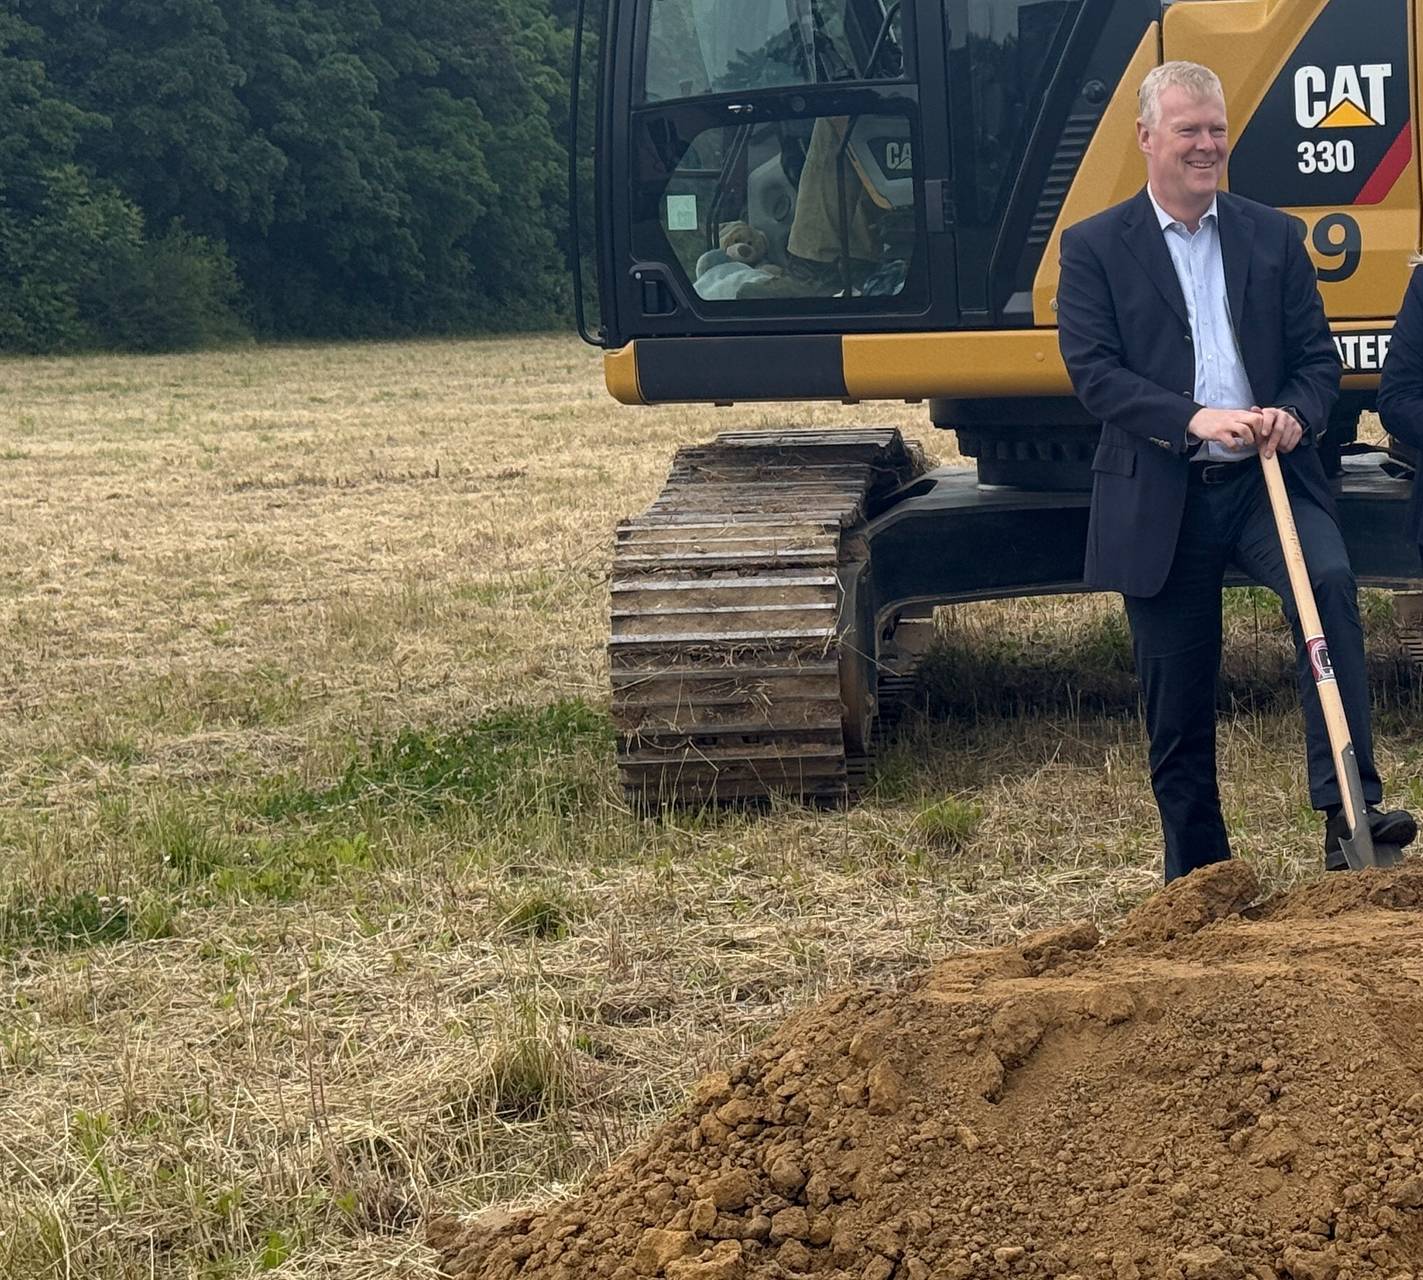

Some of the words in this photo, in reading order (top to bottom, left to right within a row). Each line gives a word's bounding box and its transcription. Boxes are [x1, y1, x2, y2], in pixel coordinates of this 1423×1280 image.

[1294, 64, 1392, 129] CAT
[1297, 139, 1355, 174] 330
[1300, 213, 1362, 282] 9
